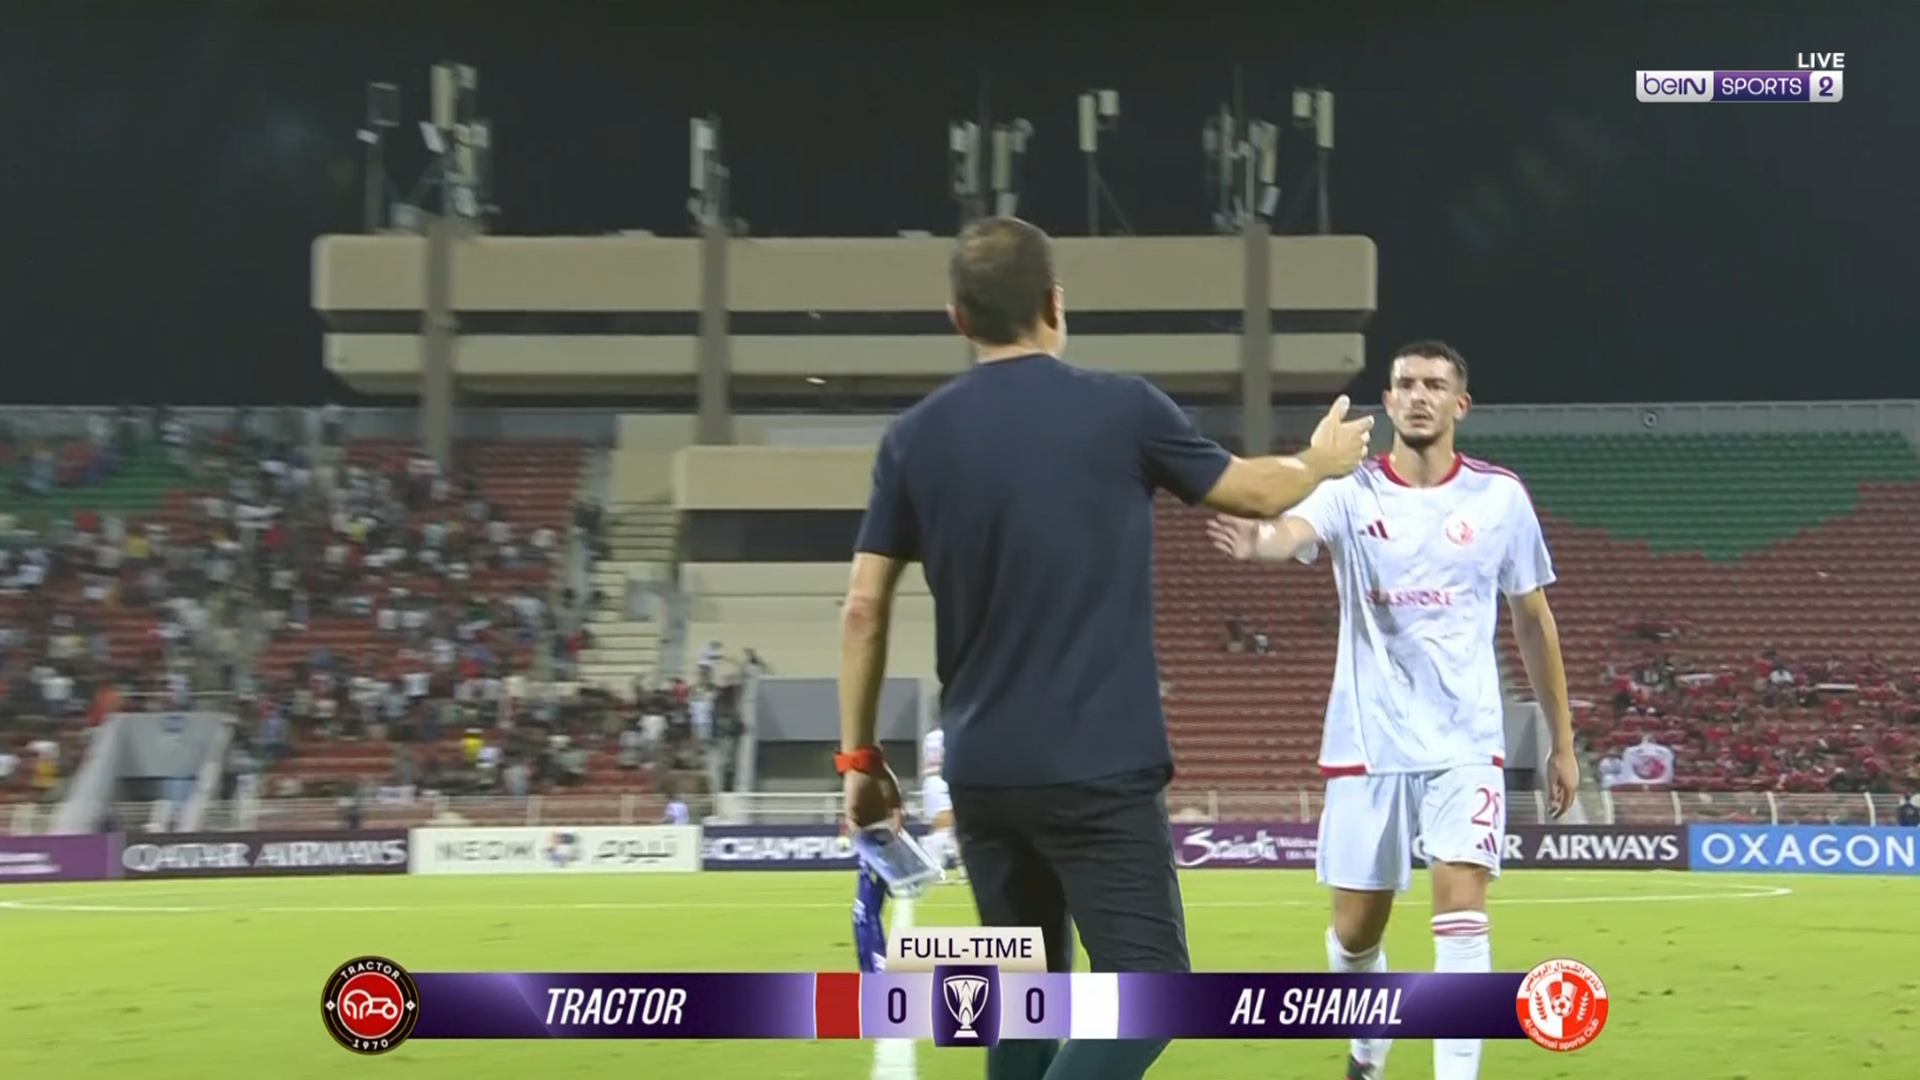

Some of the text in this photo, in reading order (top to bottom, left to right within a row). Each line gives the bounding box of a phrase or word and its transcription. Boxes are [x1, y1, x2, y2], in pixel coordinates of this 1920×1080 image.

[121, 839, 408, 872] QATAR AIRWAYS
[1535, 834, 1679, 861] AIRWAYS
[1701, 833, 1915, 867] OXAGON
